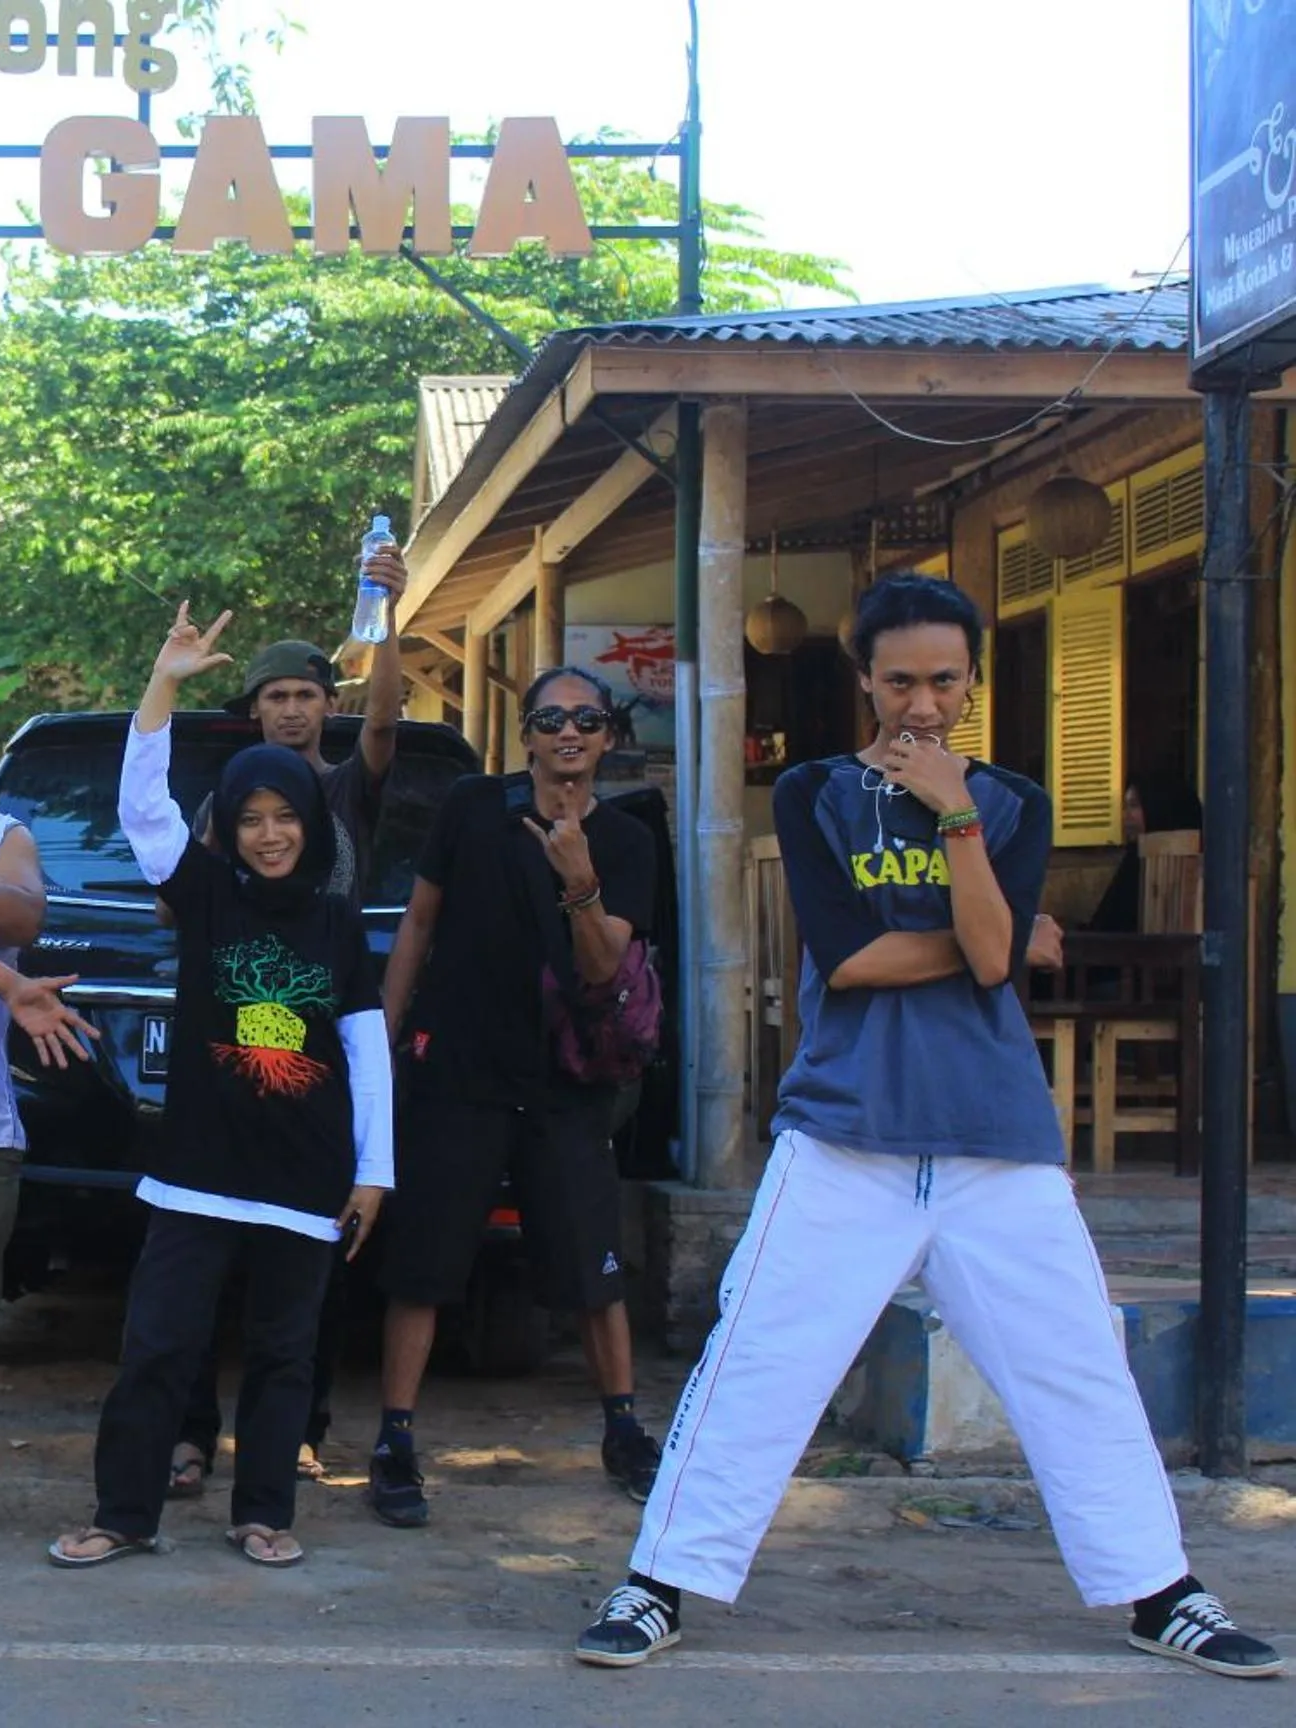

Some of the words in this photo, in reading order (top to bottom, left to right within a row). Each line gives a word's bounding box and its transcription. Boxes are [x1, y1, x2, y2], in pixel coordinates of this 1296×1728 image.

[39, 114, 594, 258] GAMA
[850, 847, 952, 891] KAPA
[149, 1020, 167, 1054] N
